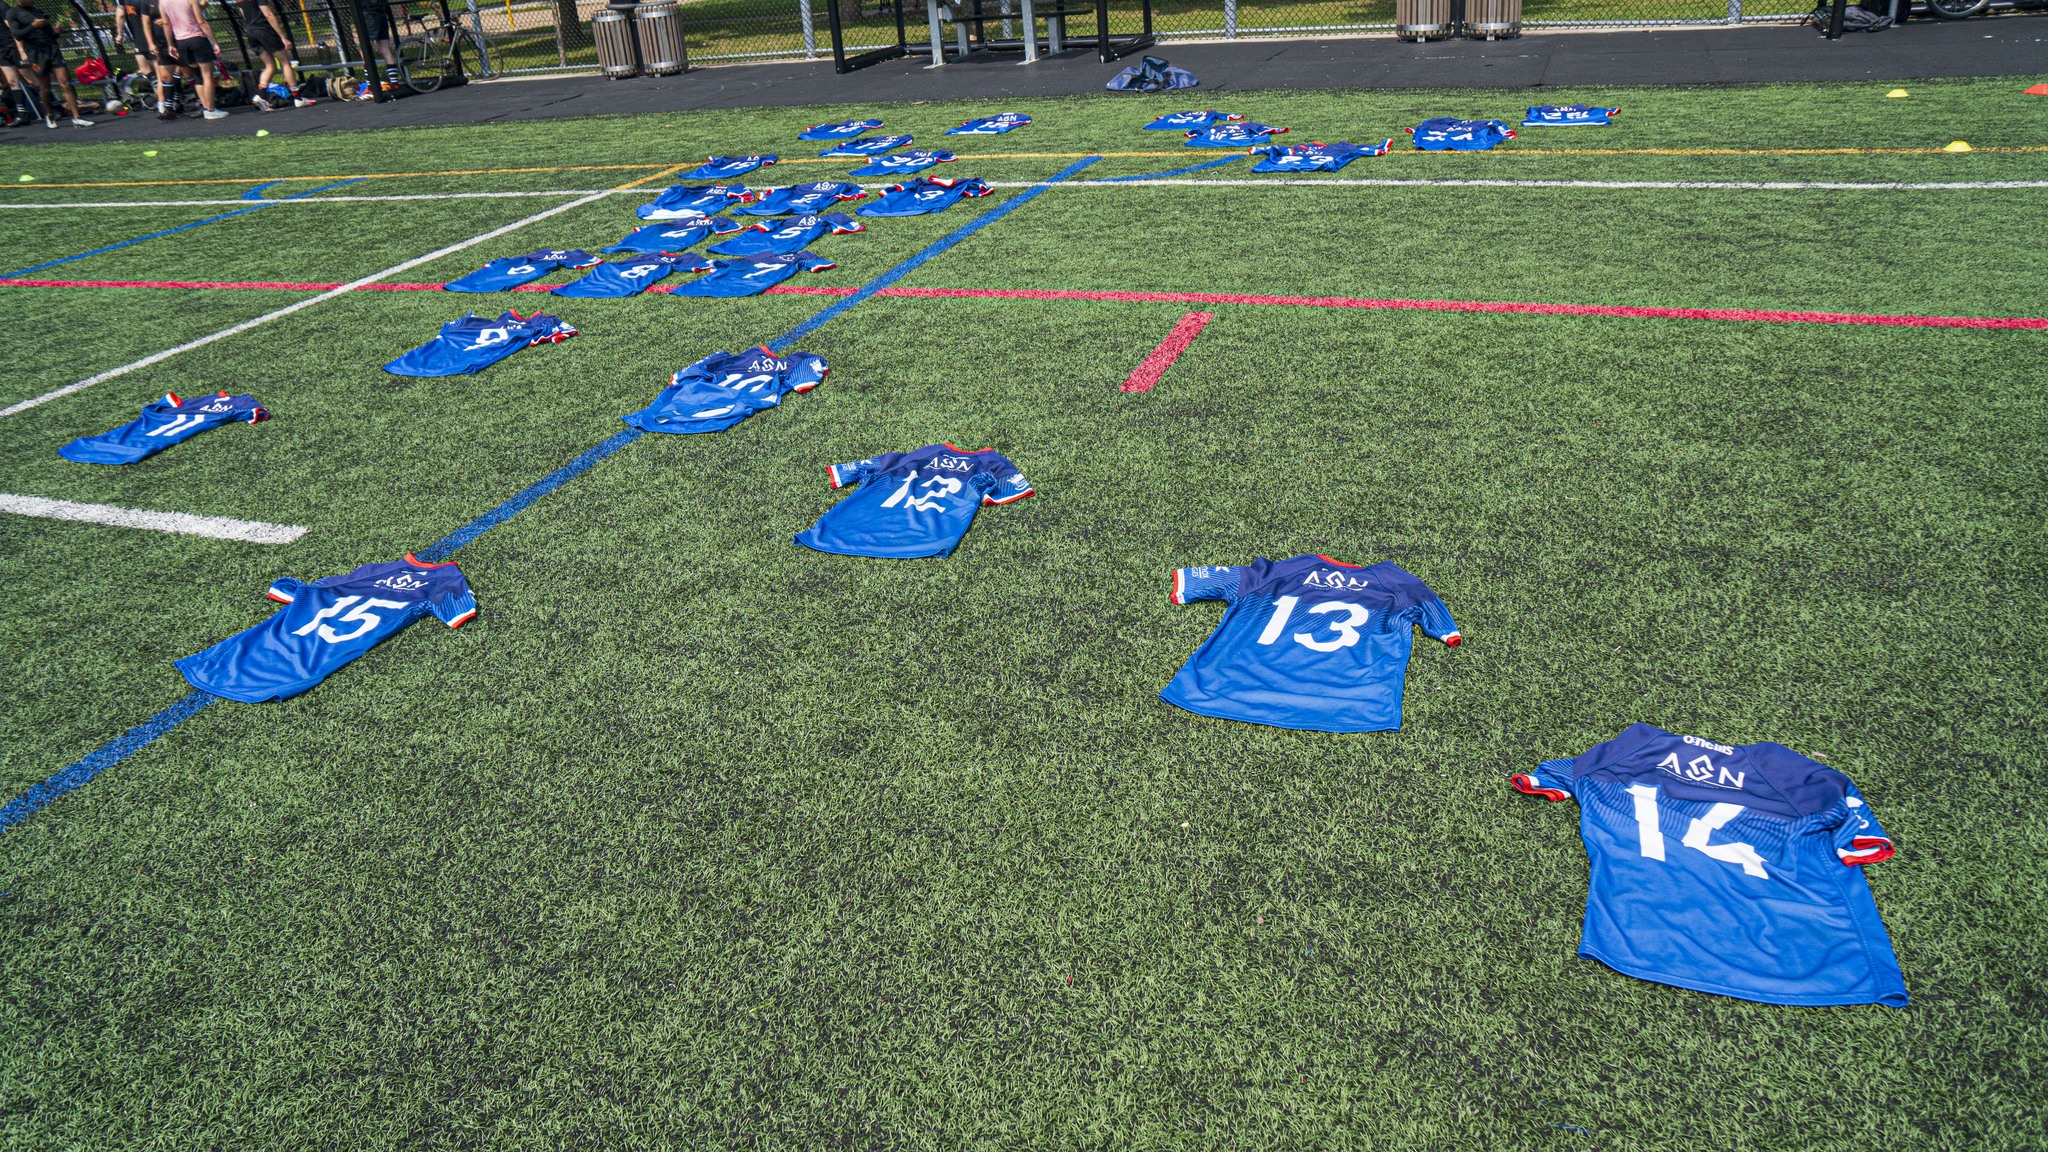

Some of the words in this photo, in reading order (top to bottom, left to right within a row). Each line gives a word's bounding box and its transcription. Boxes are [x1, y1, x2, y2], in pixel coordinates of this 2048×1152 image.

[742, 262, 787, 278] 7
[747, 358, 787, 371] ASN
[146, 414, 204, 436] 11
[880, 470, 962, 513] 12
[291, 595, 410, 644] 15
[1257, 595, 1369, 652] 13
[1625, 785, 1769, 880] 14
